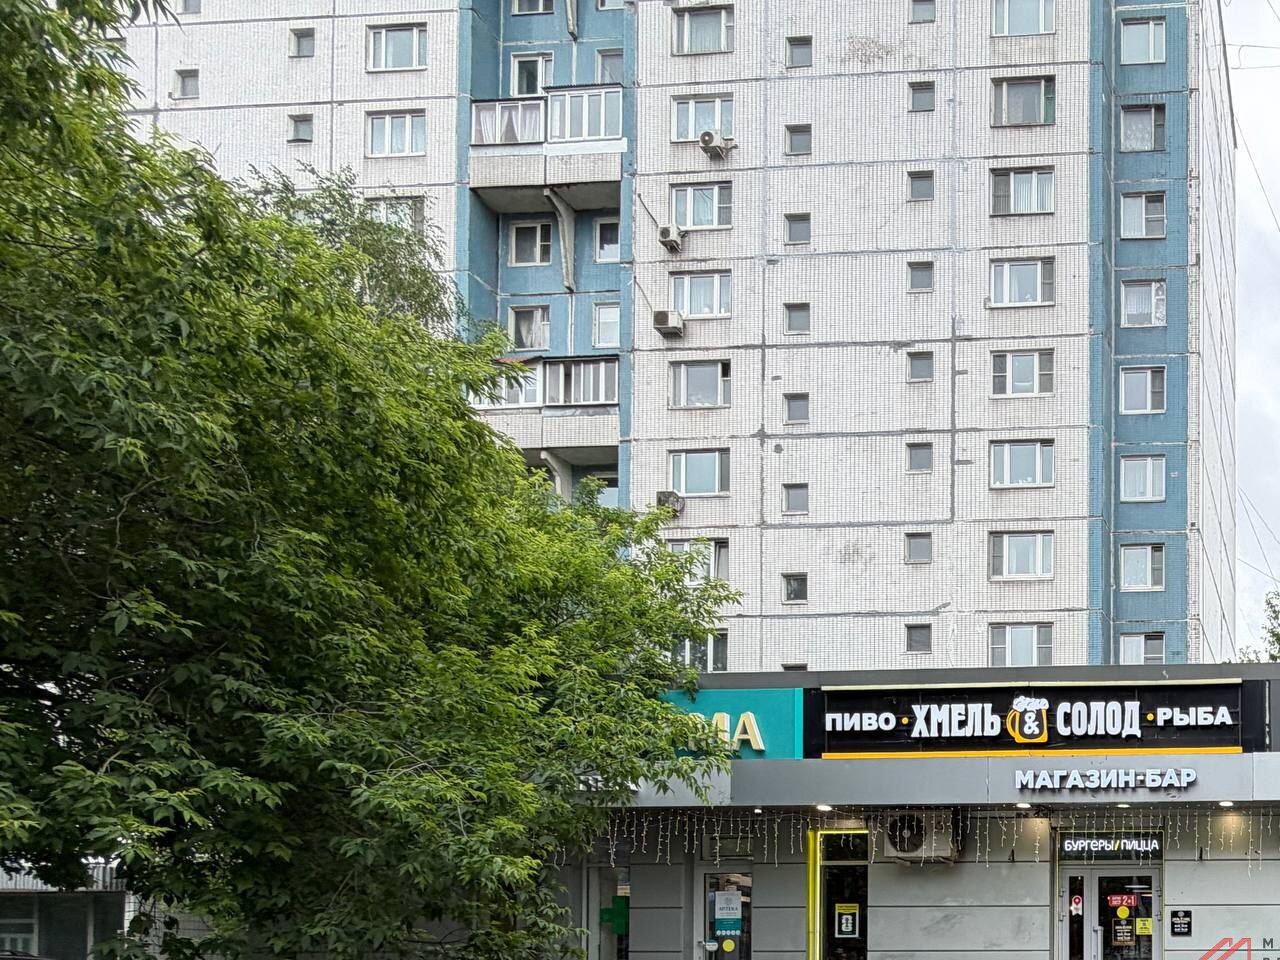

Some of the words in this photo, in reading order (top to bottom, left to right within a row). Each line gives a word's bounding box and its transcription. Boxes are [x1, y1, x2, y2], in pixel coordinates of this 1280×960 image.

[825, 712, 897, 732] ПИВО
[911, 703, 1001, 738] ХМЕЛЬ
[1023, 712, 1040, 735] &
[1056, 701, 1142, 739] СОЛОД
[1157, 706, 1233, 726] РЫБА
[1015, 768, 1197, 789] МАГАЗИН-БАР
